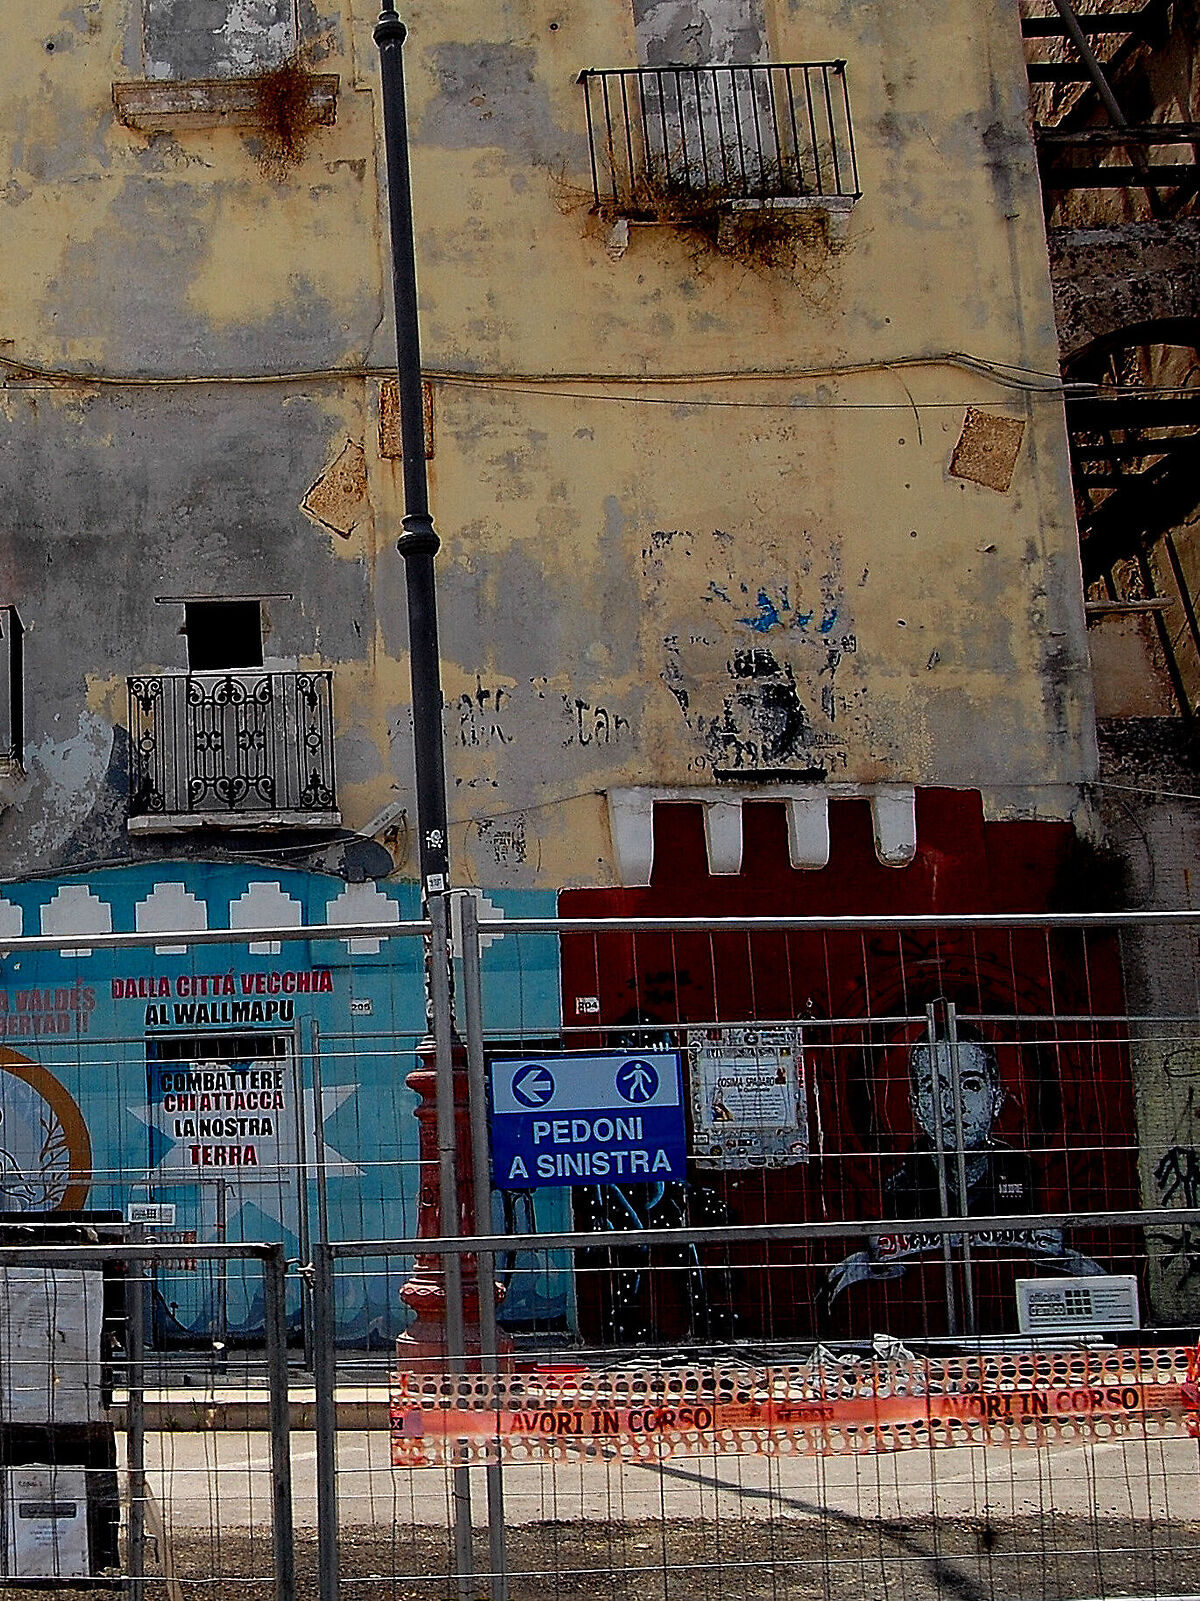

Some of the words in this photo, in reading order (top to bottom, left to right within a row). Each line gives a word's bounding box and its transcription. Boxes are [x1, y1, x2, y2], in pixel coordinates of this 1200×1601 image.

[112, 976, 171, 999] DALLA
[240, 970, 334, 996] VECCHIA
[145, 1003, 170, 1026] AL
[174, 999, 295, 1025] WALLMAPU
[160, 1069, 283, 1093] COMBATTERE
[164, 1093, 197, 1113] CHI
[201, 1090, 285, 1112] ATTACCA
[174, 1118, 195, 1138] LA
[197, 1116, 274, 1138] NOSTRA
[533, 1116, 643, 1145] PEDONI
[188, 1143, 258, 1166] TERRA
[508, 1156, 529, 1179] A
[536, 1149, 672, 1178] SINISTRA
[1021, 1391, 1049, 1416] IN
[1056, 1387, 1139, 1413] CORSO
[591, 1411, 620, 1435] IN
[627, 1407, 712, 1433] CORSO
